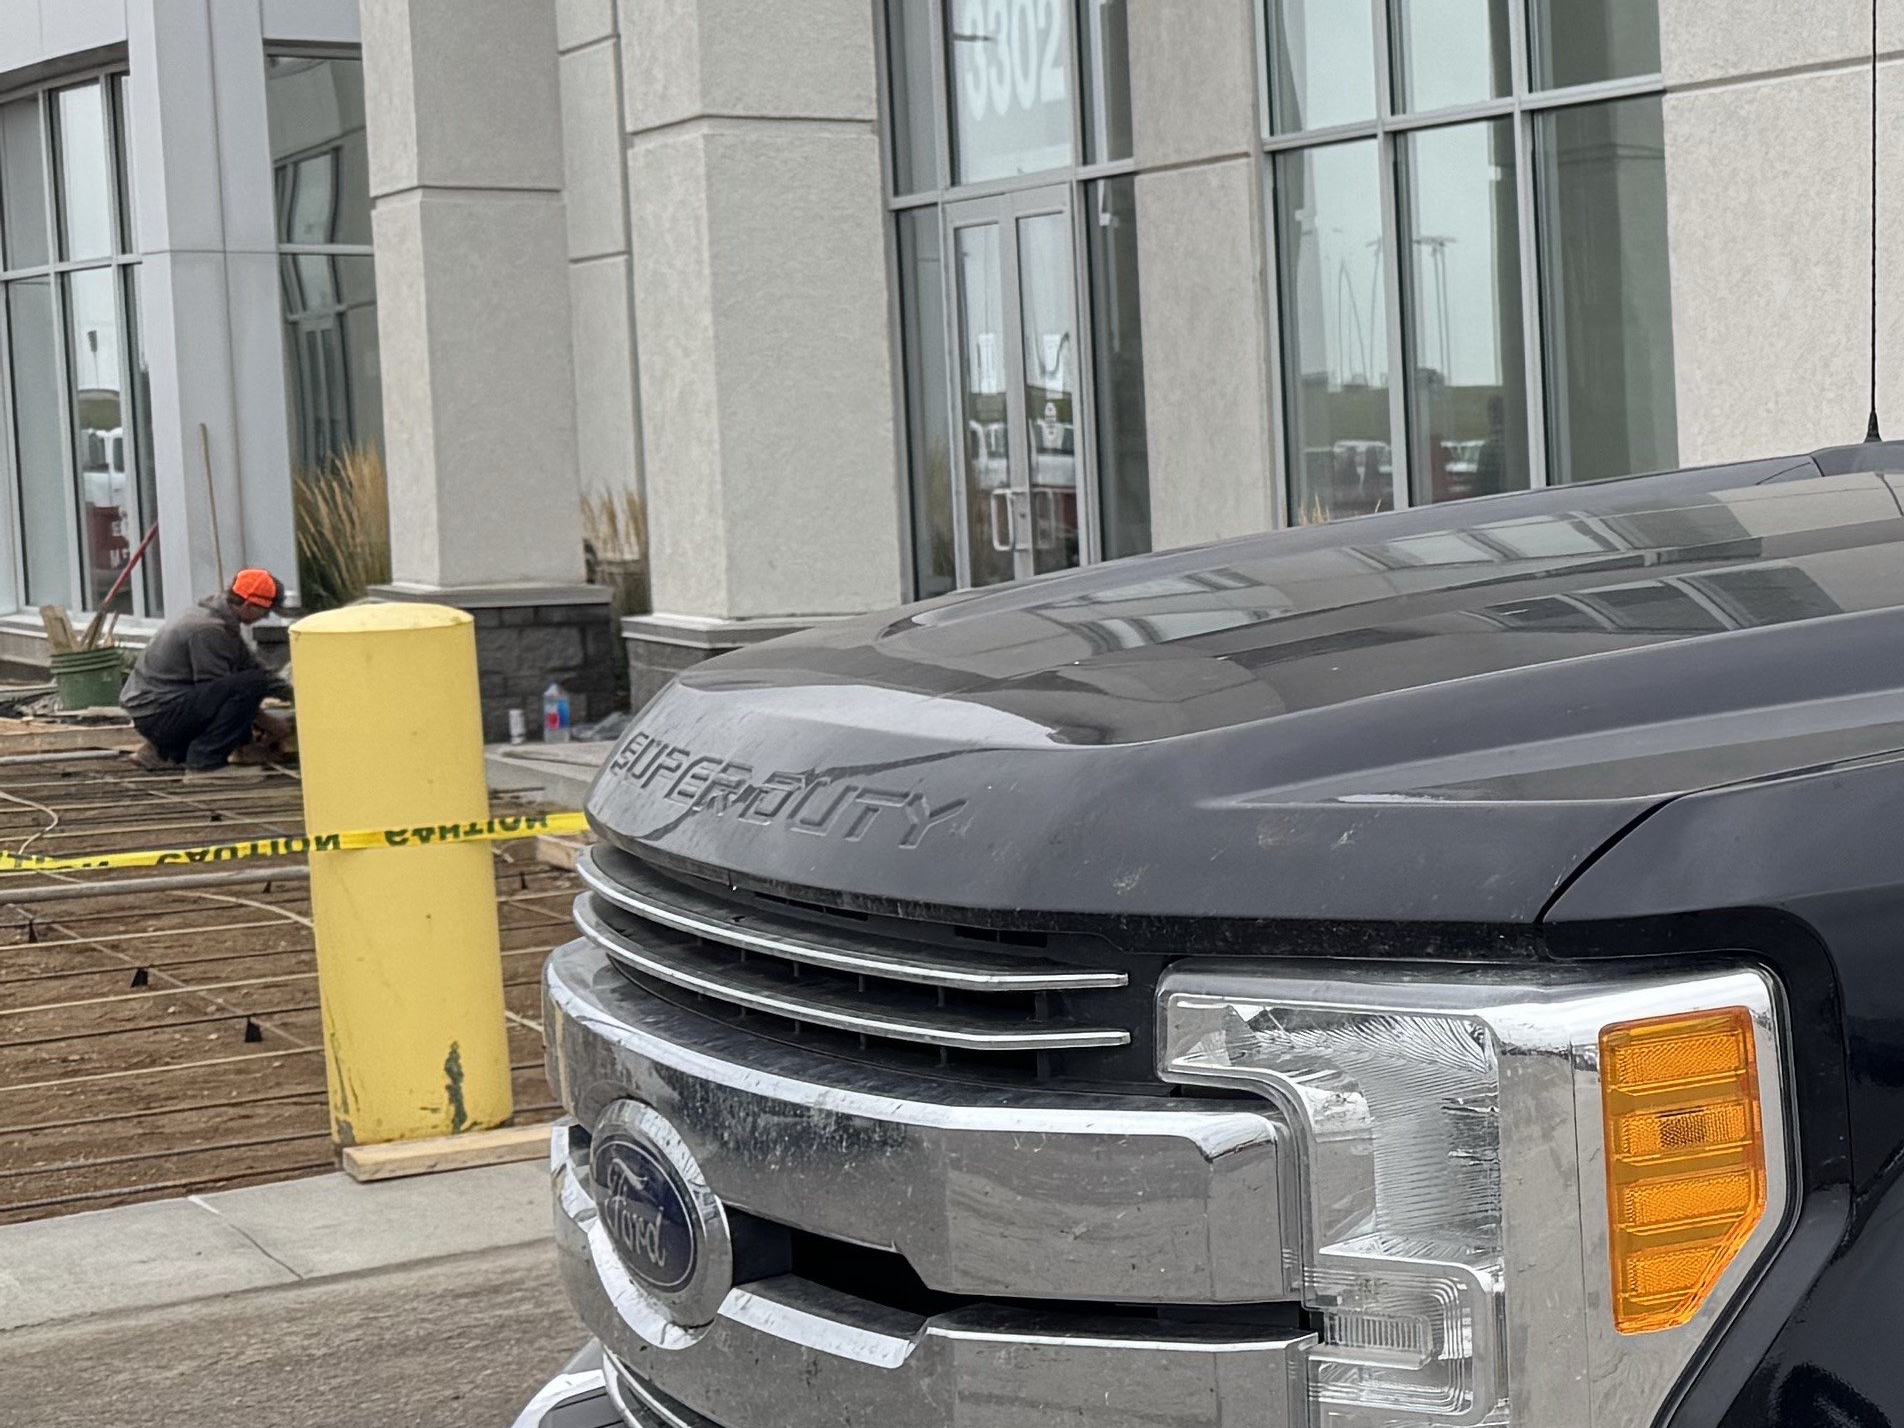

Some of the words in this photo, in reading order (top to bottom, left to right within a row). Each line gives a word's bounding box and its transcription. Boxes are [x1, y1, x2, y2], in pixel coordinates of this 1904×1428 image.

[609, 731, 753, 817] SUPER
[738, 770, 968, 849] DUTY
[604, 1158, 666, 1267] Ford
